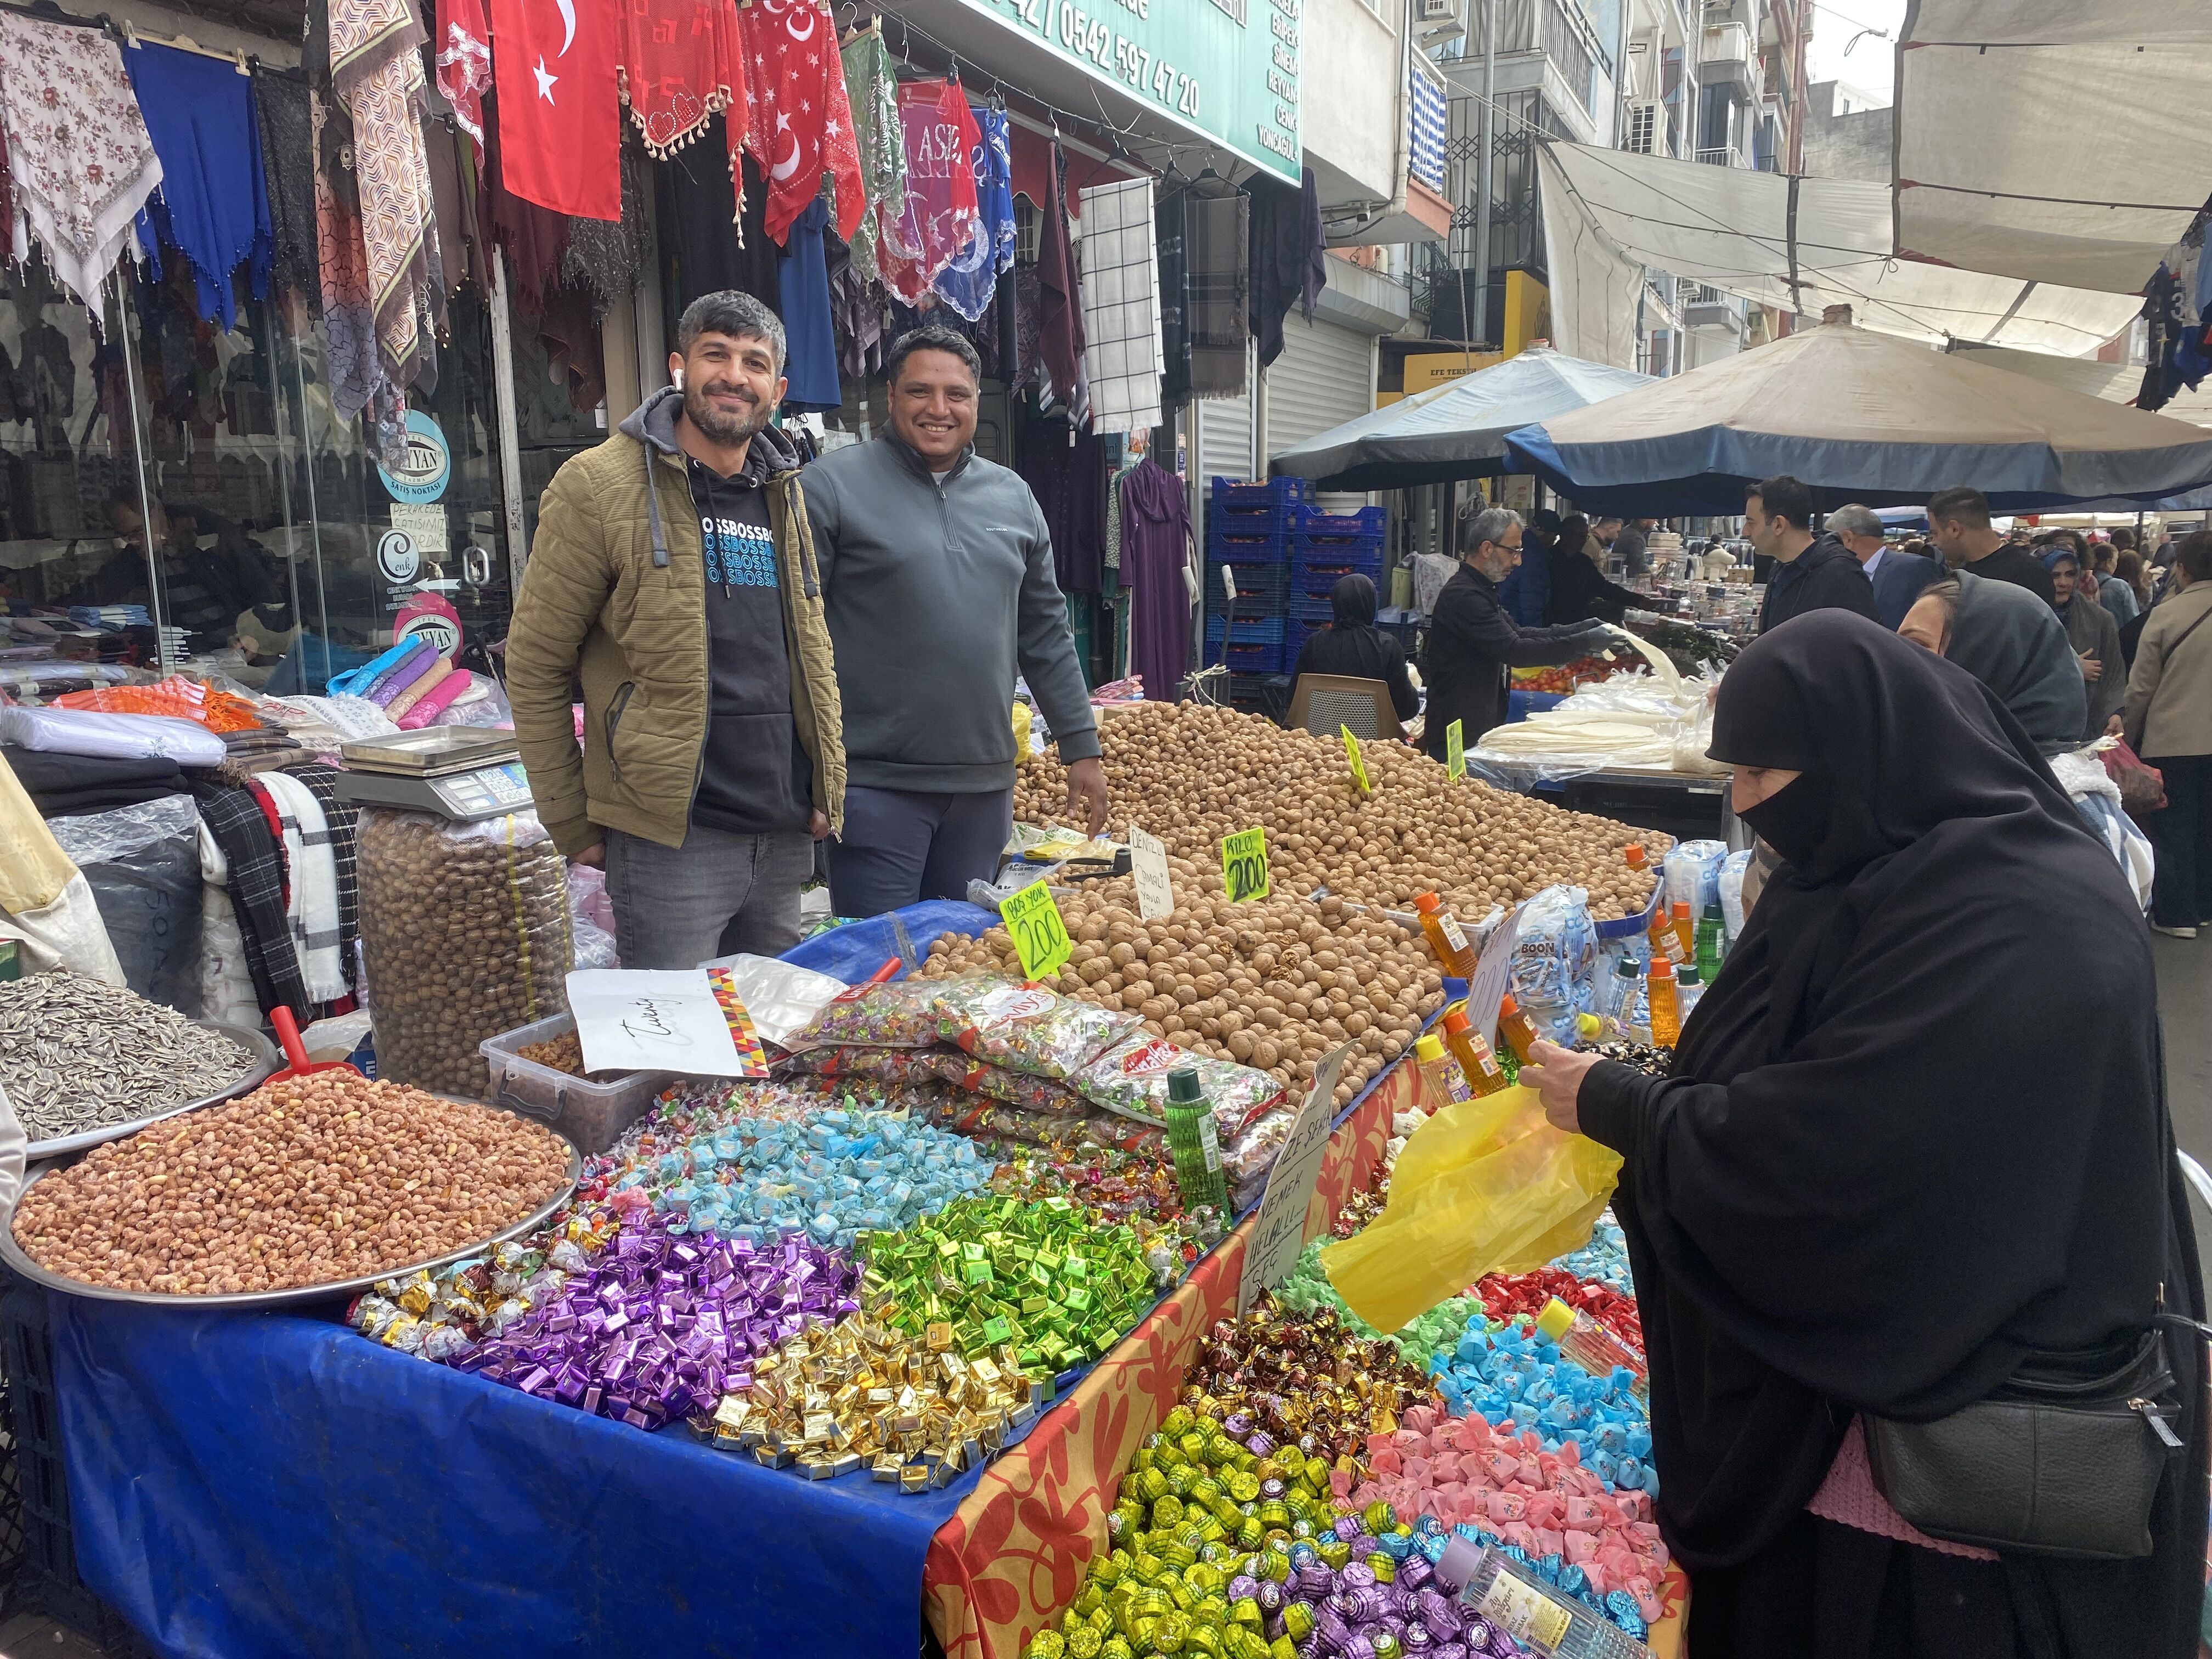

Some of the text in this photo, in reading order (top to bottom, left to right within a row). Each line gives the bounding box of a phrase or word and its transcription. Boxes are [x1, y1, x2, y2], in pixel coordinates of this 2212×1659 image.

[1270, 12, 1297, 48] ERİPEK
[1058, 0, 1110, 70] 0542
[1153, 59, 1176, 105] 47
[1178, 72, 1200, 119] 20
[1272, 42, 1296, 76] SİNEM
[1267, 69, 1296, 104] REYYAN
[1276, 104, 1295, 132] CENK
[1256, 123, 1295, 162] YONCAGÜL
[391, 481, 441, 496] SATIŞ NOKTASI
[393, 504, 442, 517] PERAKEDE
[1226, 835, 1252, 855] KİLO
[1228, 854, 1266, 903] 200
[1007, 885, 1046, 919] BOŞ YOK
[1018, 910, 1062, 973] 200
[1521, 942, 1555, 953] BOON
[619, 998, 682, 1037] Twenty
[1257, 1169, 1303, 1233] YEMEK
[1489, 1595, 1500, 1609] Ay
[1513, 1614, 1528, 1637] ZAMBAK
